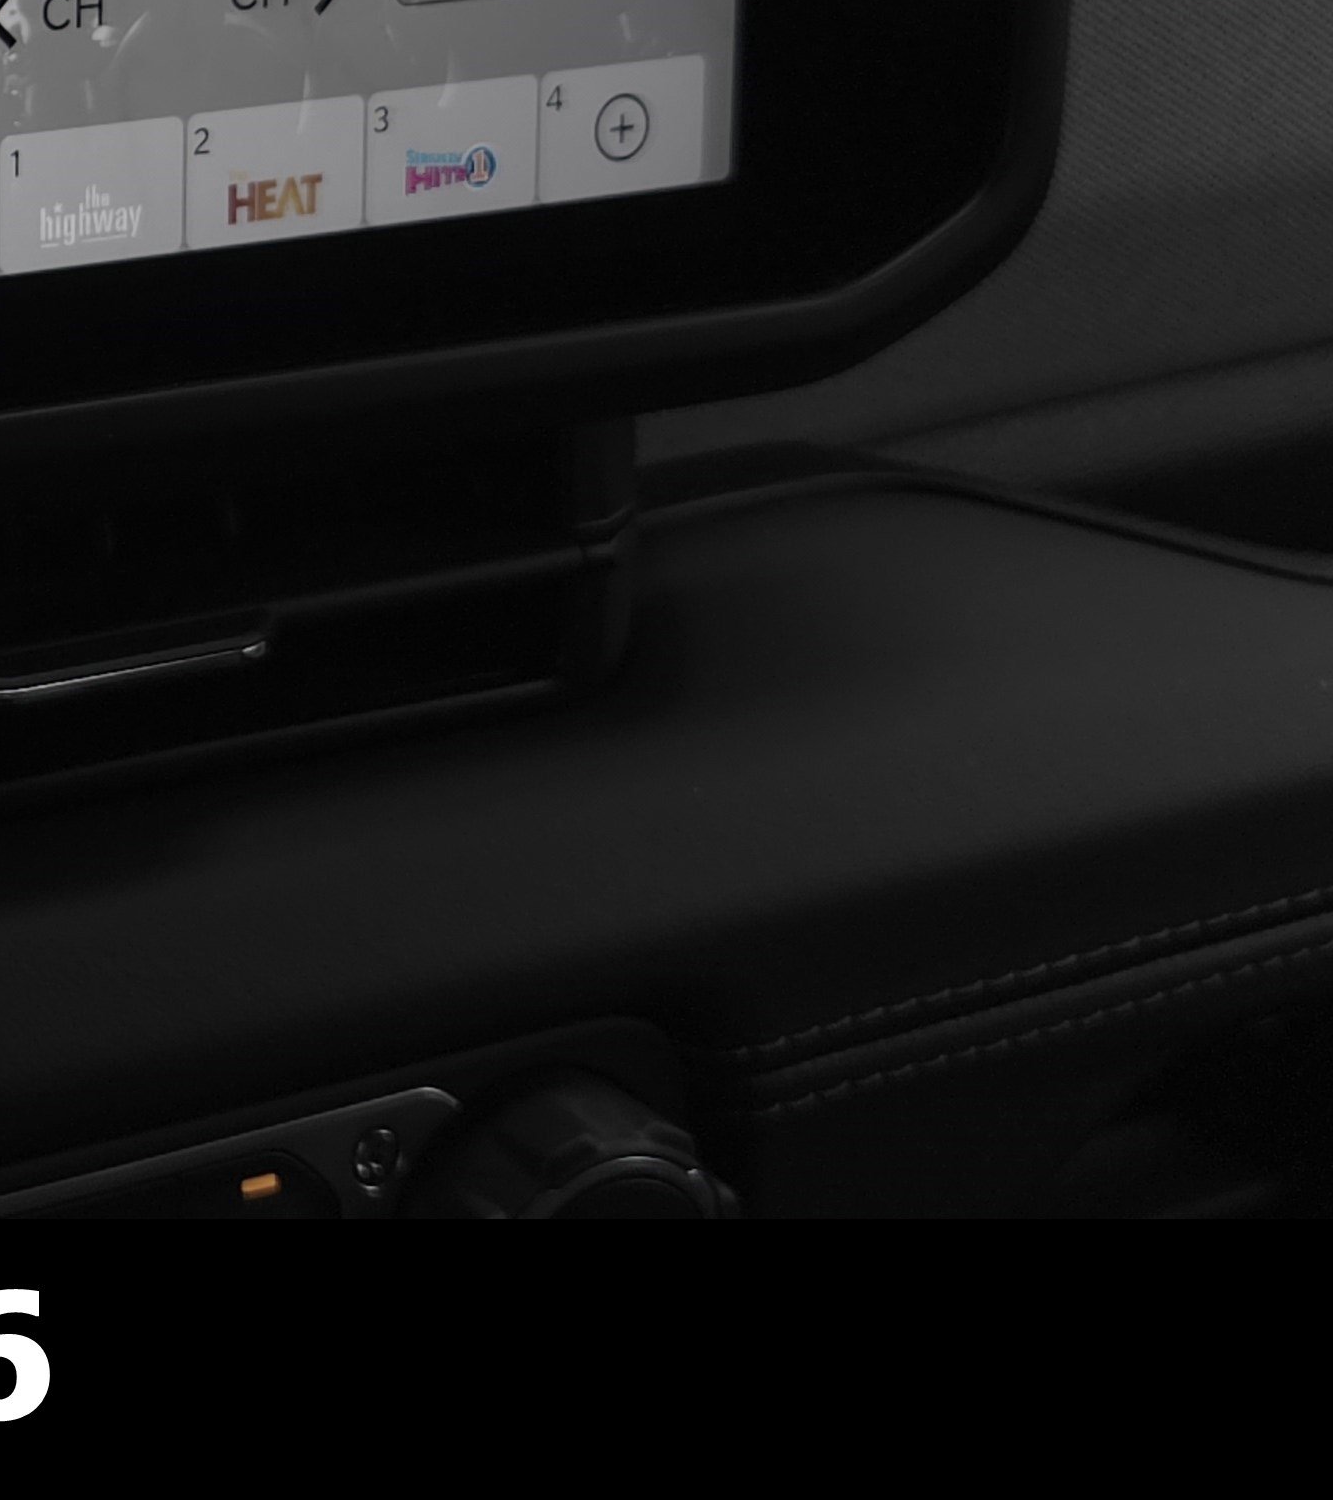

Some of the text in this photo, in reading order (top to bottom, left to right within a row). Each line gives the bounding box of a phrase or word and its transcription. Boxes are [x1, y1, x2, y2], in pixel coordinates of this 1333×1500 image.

[544, 84, 562, 112] 4
[373, 105, 390, 134] 3
[193, 127, 211, 156] 2
[10, 149, 20, 178] 1
[227, 174, 323, 226] HEAT
[39, 202, 143, 246] highway
